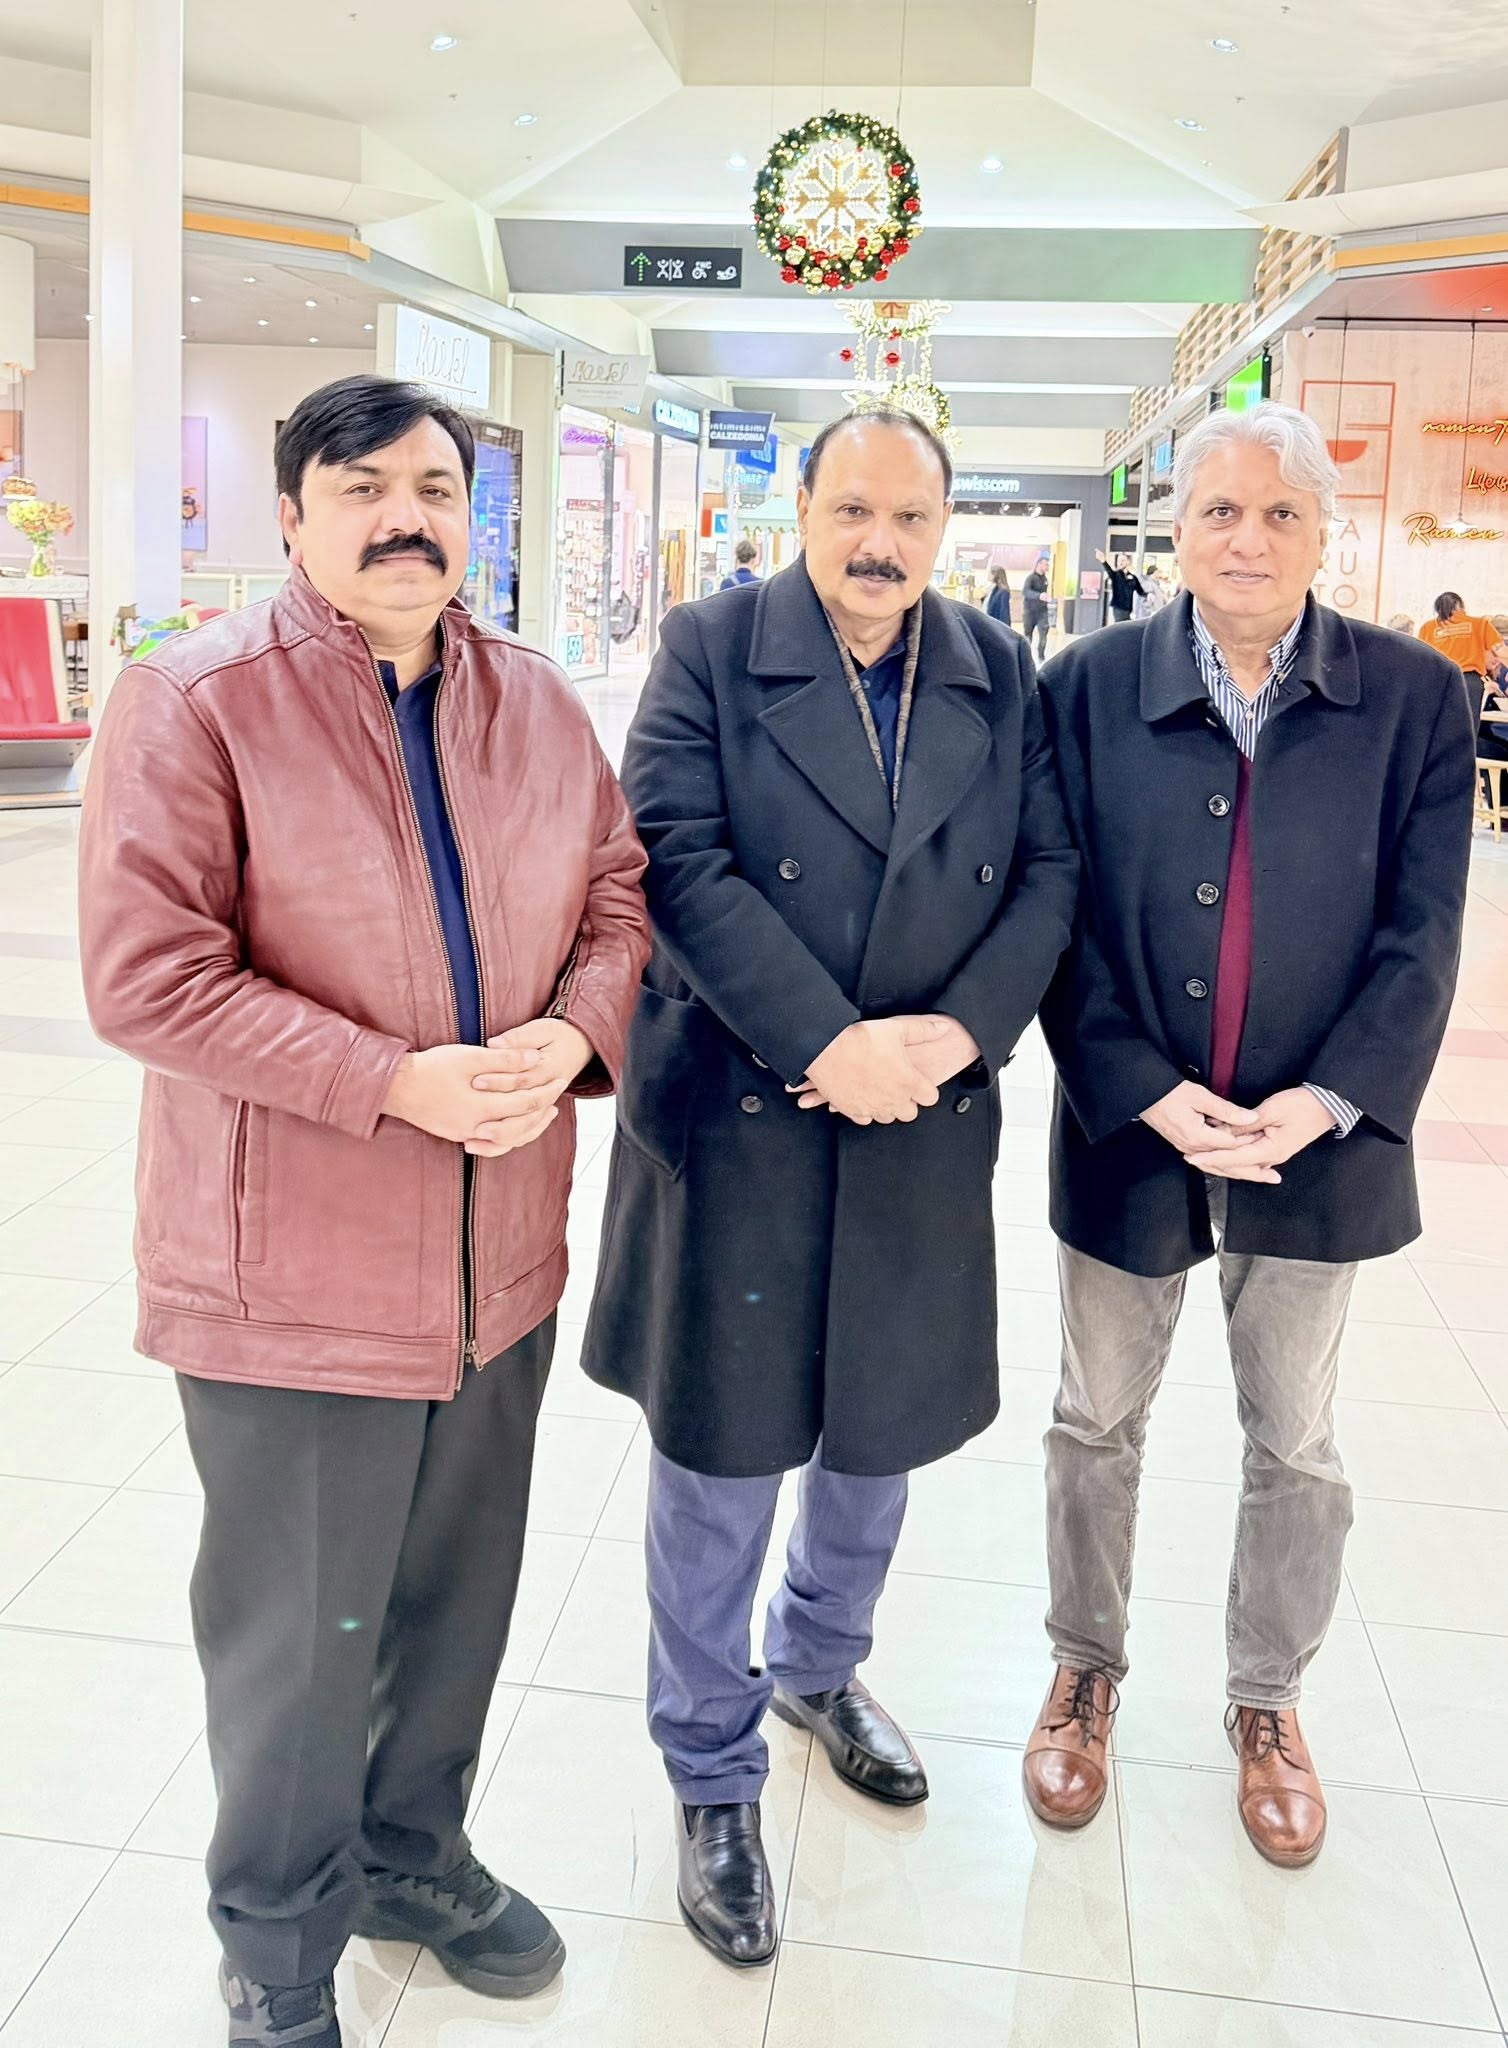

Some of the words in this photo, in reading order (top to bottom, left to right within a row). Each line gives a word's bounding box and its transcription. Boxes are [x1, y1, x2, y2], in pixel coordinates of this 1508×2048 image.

[709, 431, 765, 442] CALZEDONIA
[951, 475, 1020, 493] swisscom
[1402, 512, 1504, 547] Ramen
